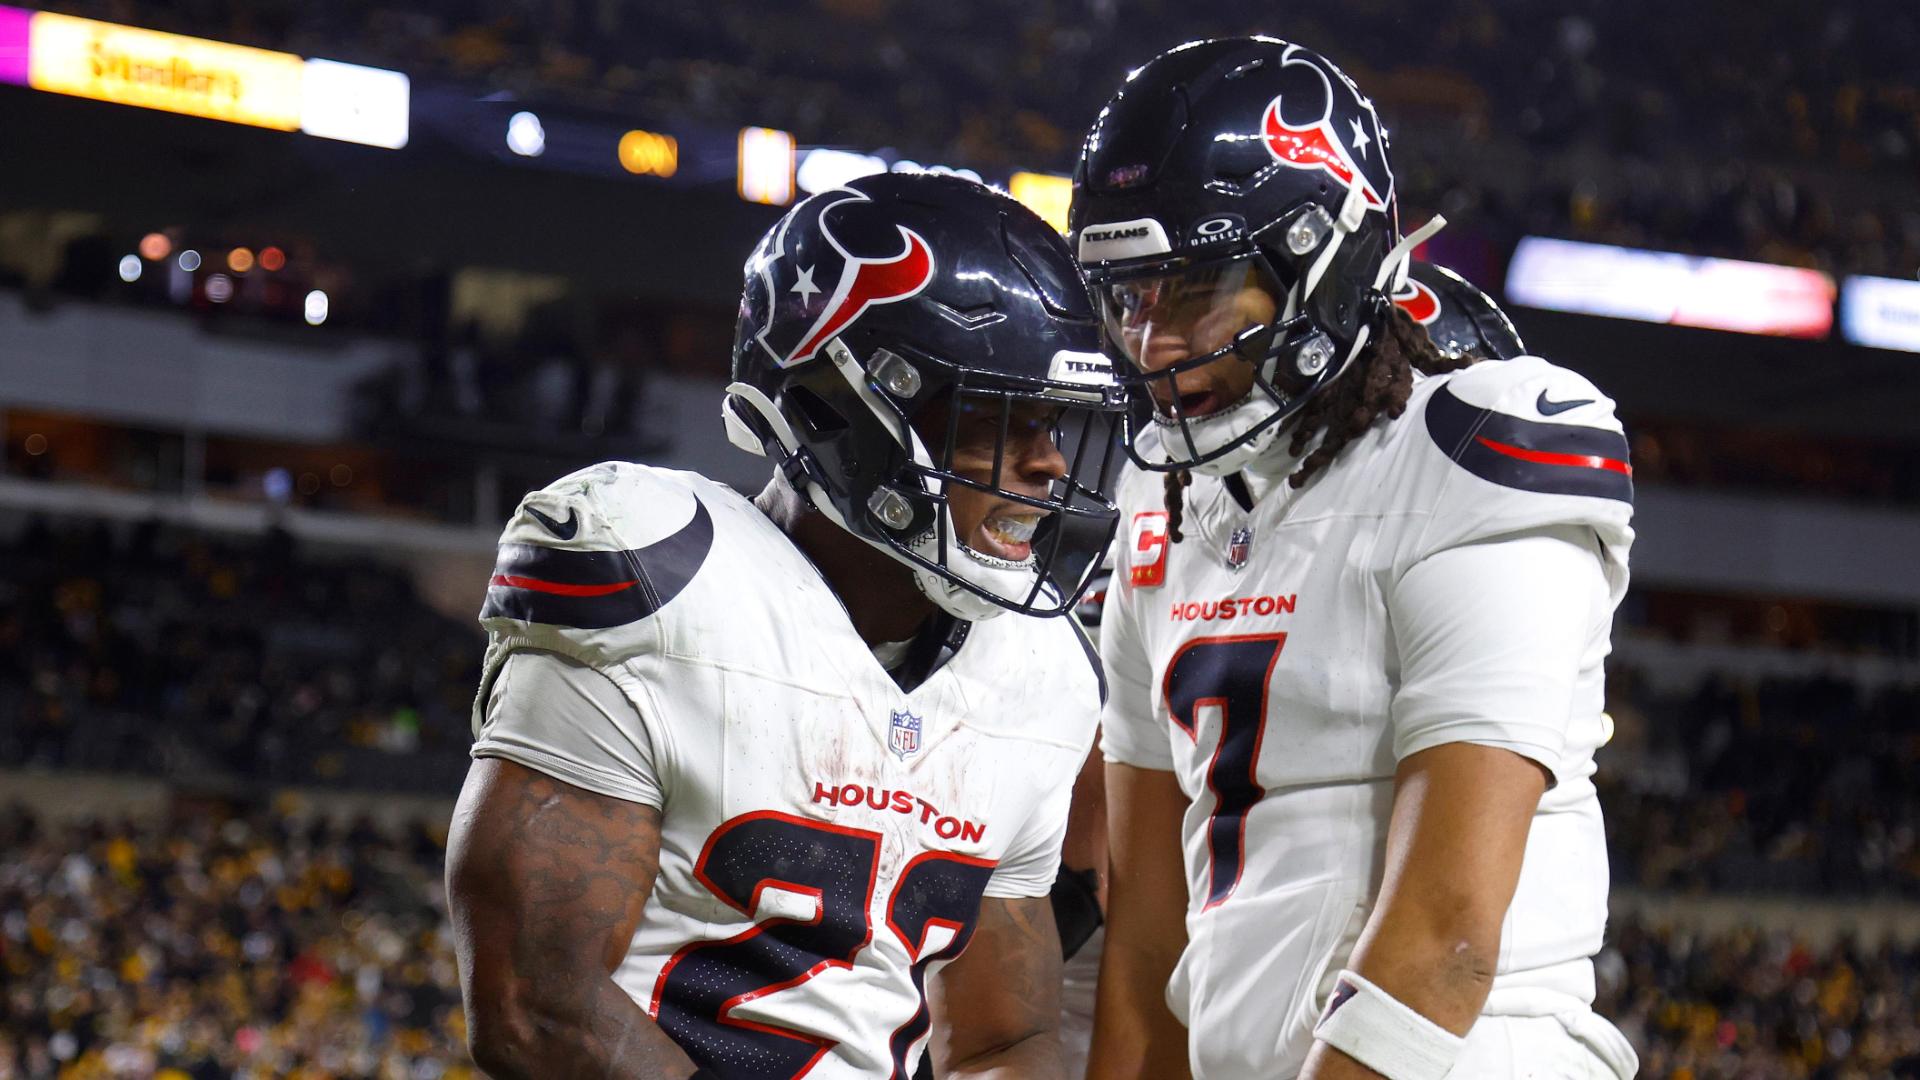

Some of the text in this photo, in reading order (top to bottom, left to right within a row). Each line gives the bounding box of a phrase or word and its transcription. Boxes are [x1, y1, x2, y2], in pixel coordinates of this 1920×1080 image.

[1084, 227, 1149, 242] TEXANS
[1191, 228, 1242, 247] OAKLEY
[1131, 515, 1167, 567] C
[1170, 594, 1297, 621] HOUSTON
[1163, 632, 1288, 913] 7
[812, 782, 987, 843] HOUSTON
